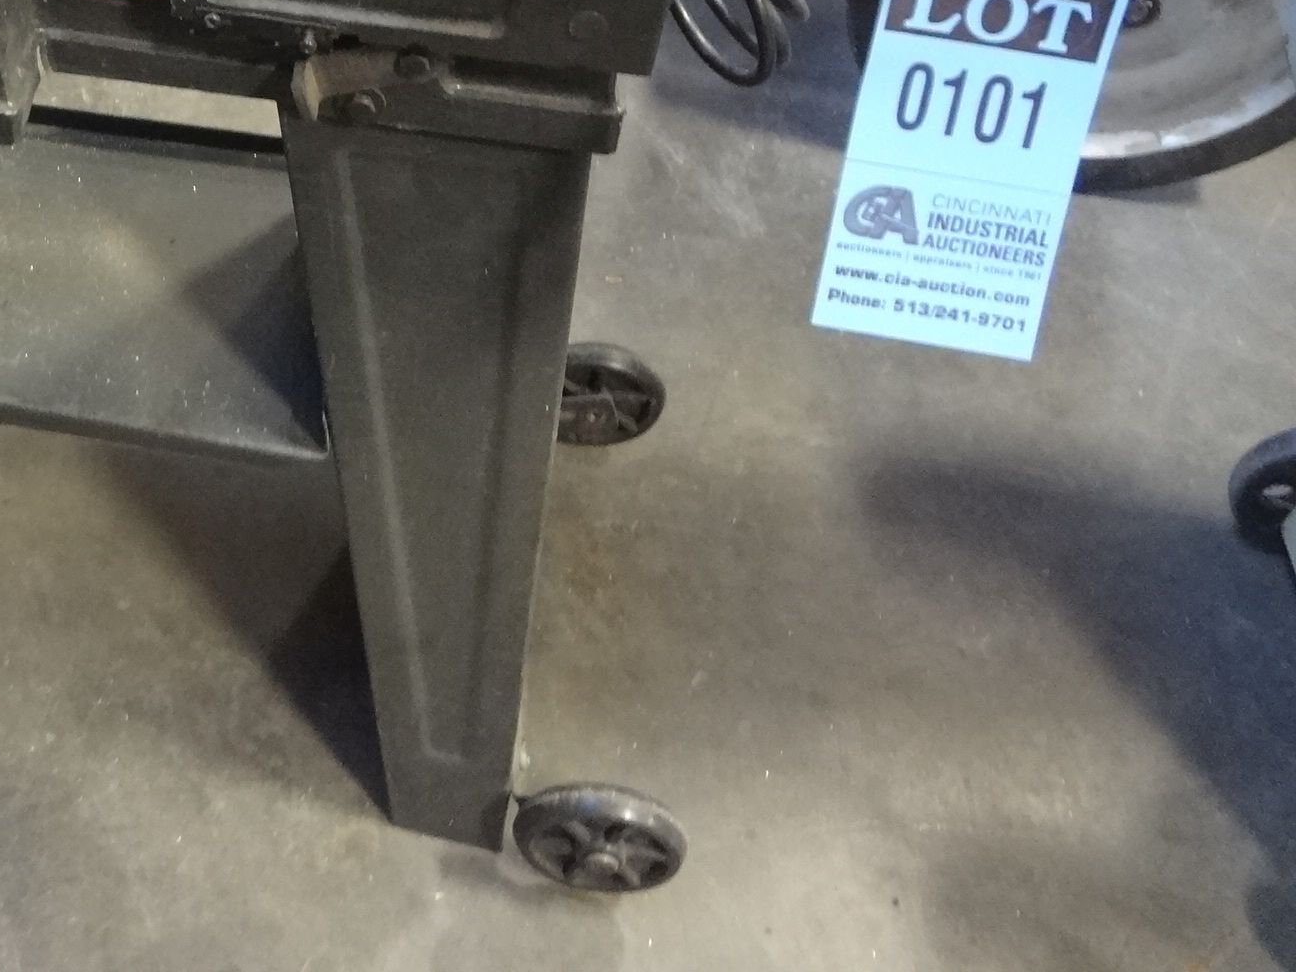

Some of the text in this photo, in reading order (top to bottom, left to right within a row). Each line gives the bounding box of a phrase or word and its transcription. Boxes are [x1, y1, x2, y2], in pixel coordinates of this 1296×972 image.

[896, 61, 1049, 150] 0101
[932, 193, 1051, 226] CINCINNATI
[927, 211, 1049, 249] INDUSTRIAL
[922, 234, 1046, 267] AUCTIONEERS
[835, 265, 1031, 307] www.cia-auction.com
[827, 287, 1027, 332] Phone: 513/241-9701
